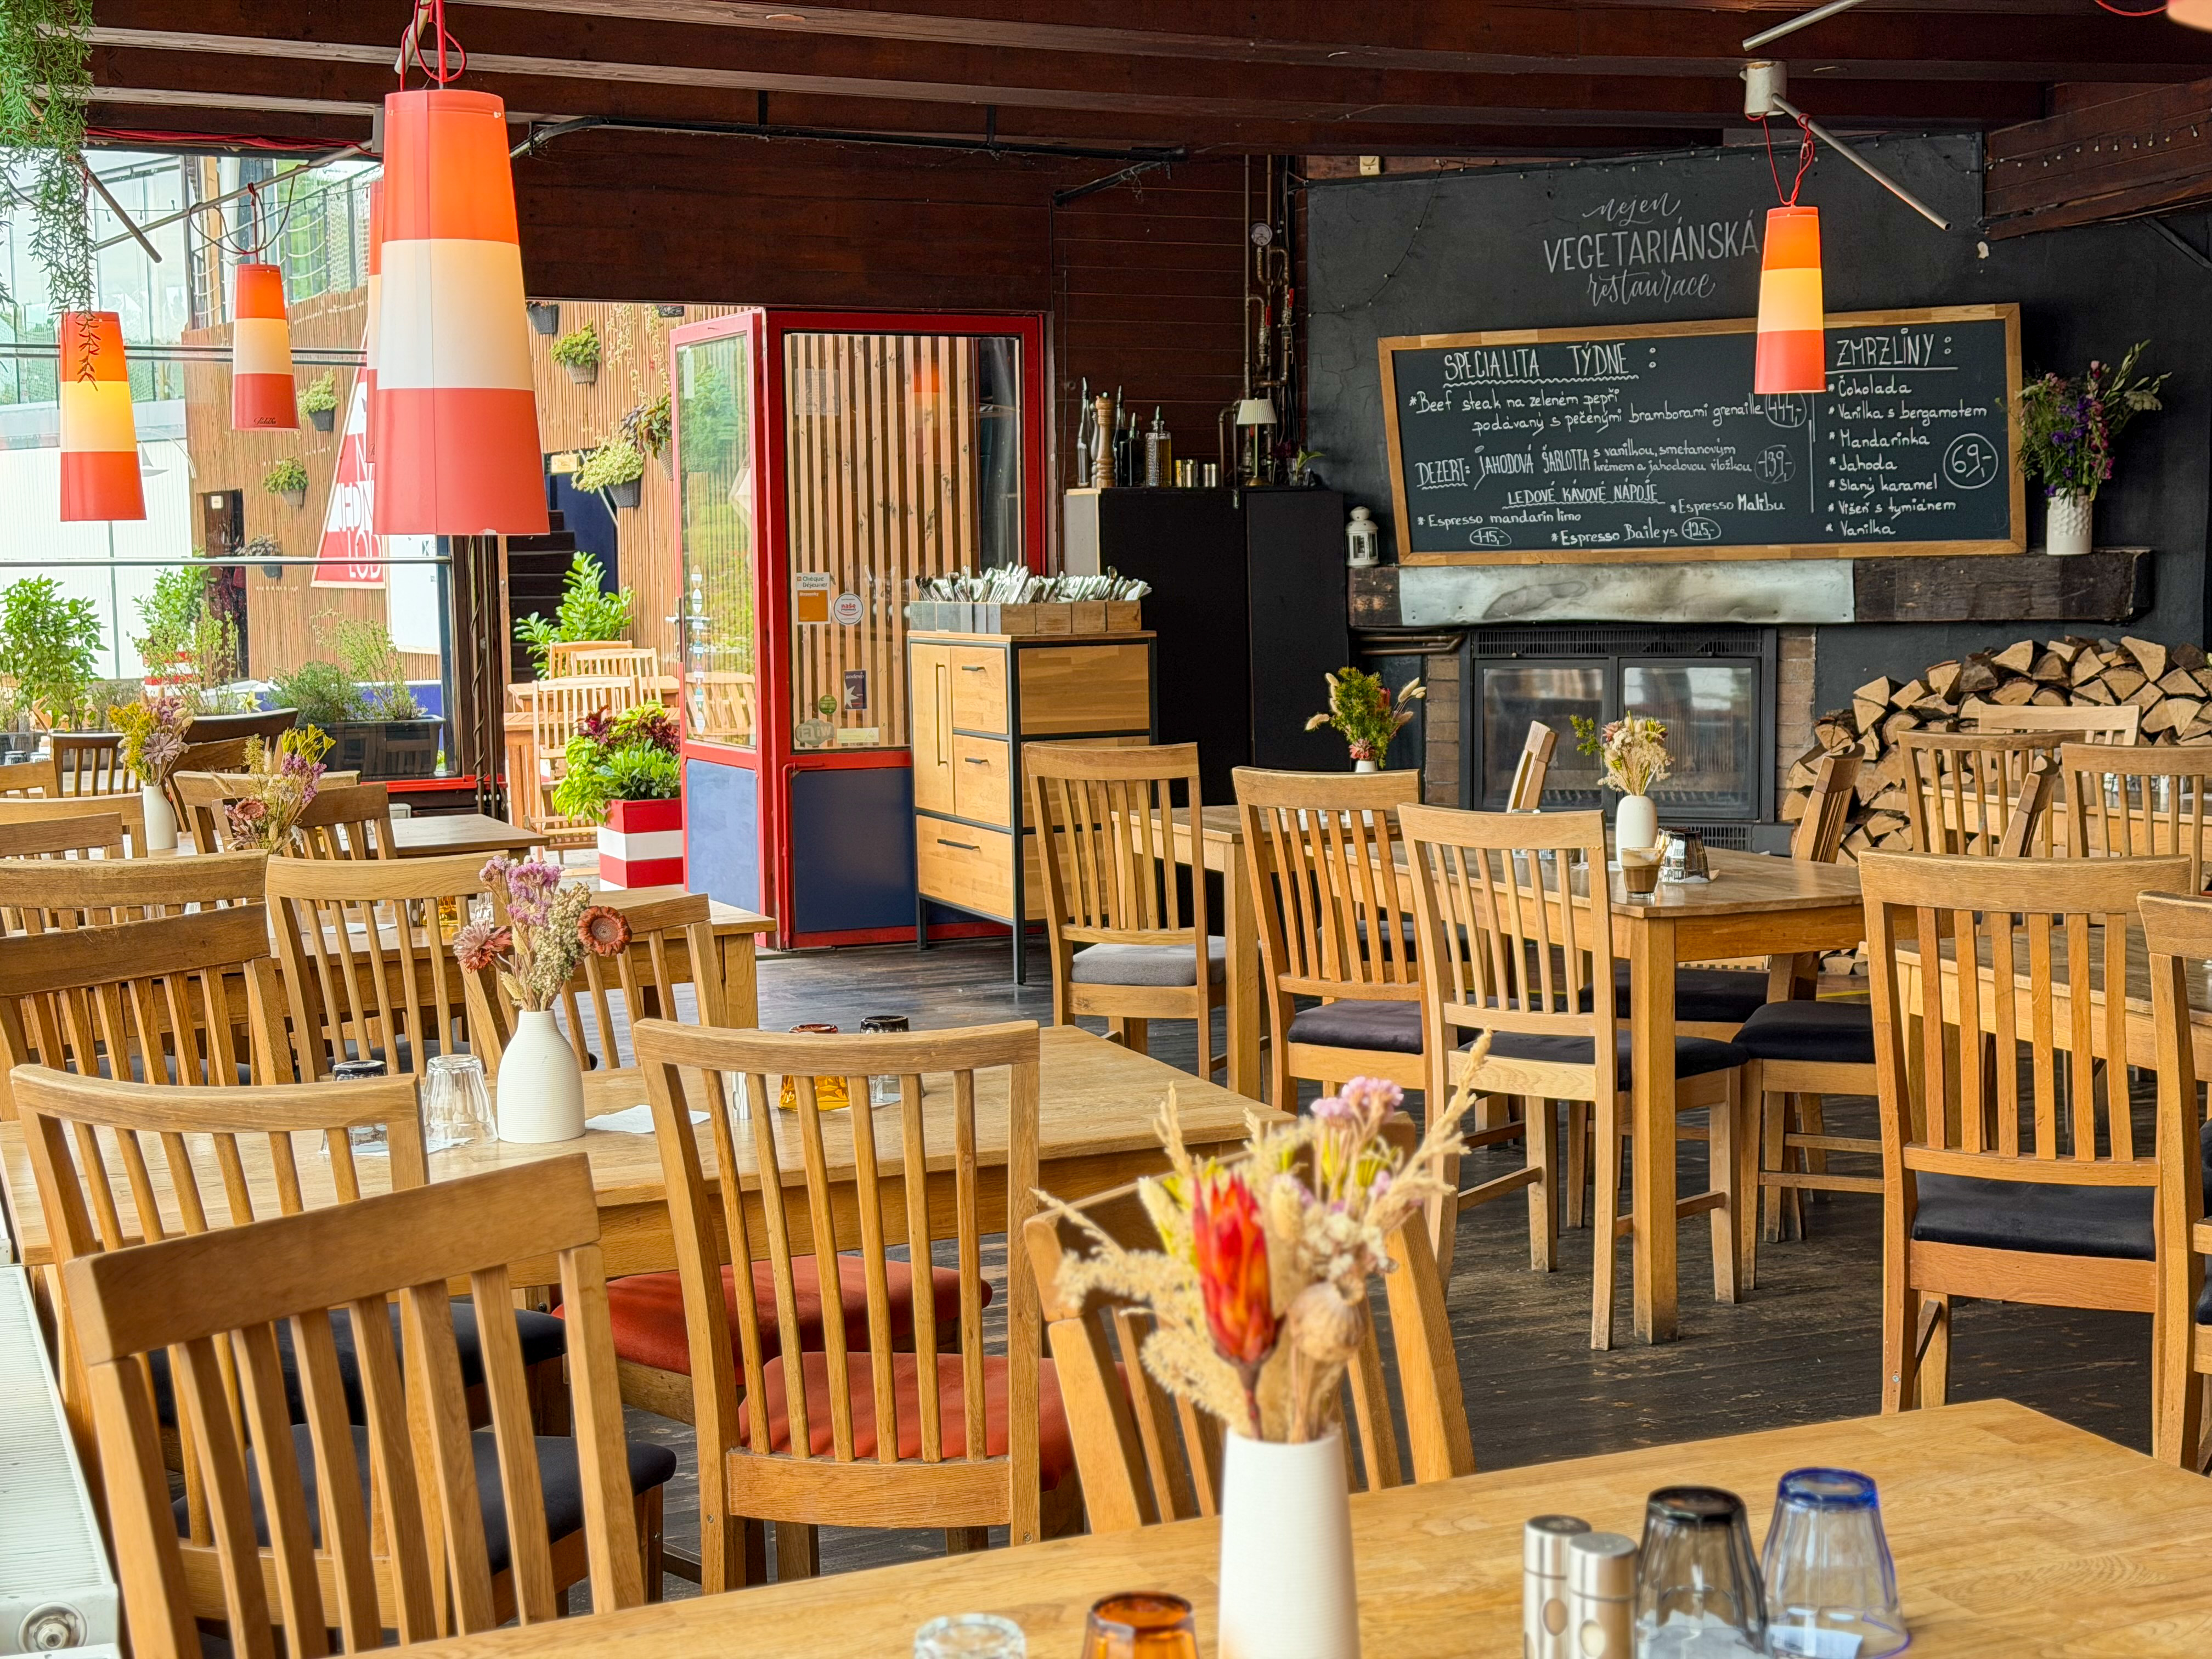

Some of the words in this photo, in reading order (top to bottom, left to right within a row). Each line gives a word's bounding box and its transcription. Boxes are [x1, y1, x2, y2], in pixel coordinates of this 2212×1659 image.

[1582, 192, 1681, 227] nejen
[1543, 209, 1760, 274] VEGETARIÁNSKÁ
[1585, 268, 1716, 307] restaurace
[1443, 349, 1540, 381] SPECIALITA
[1566, 341, 1629, 376] TÝDNE
[1836, 328, 1934, 367] ZMRZLINY
[1838, 373, 1912, 397] Čokolada
[1415, 390, 1453, 414] Beef
[1462, 387, 1502, 411] steak
[1506, 398, 1525, 408] na
[1529, 388, 1579, 408] zeleném
[1838, 399, 1884, 420] Vanilka
[1887, 408, 1895, 418] s
[1899, 398, 1988, 427] bergamotem
[1471, 412, 1545, 437] podávaný
[1549, 416, 1561, 427] s
[1564, 408, 1622, 434] pečenými
[1628, 399, 1708, 424] bramborami
[1712, 392, 1764, 427] grenaille
[1839, 426, 1931, 448] Mandarinka
[1542, 444, 1591, 473] ŠARLOTTA
[1593, 448, 1601, 458] s
[1838, 453, 1898, 472] Jahoda
[1594, 459, 1635, 472] krémem
[1646, 458, 1707, 478] jahodovou
[1508, 481, 1556, 505] LEDOVÉ
[1562, 478, 1606, 502] KÁVOVÉ
[1613, 477, 1658, 501] NÁPOJE
[1838, 477, 1876, 499] Slaný
[1880, 472, 1938, 492] karamel
[338, 478, 374, 533] JEDN
[1678, 498, 1734, 516] Espresso
[1737, 492, 1786, 511] Malibu
[1838, 500, 1870, 515] Višeň
[1874, 504, 1883, 514] s
[1888, 496, 1956, 520] tymiánem
[1428, 514, 1483, 531] Espresso
[1489, 509, 1554, 523] mandarin
[1556, 507, 1582, 522] limo
[1560, 529, 1620, 547] Espresso
[1623, 516, 1678, 543] Baileys
[1840, 519, 1896, 537] Vanilka
